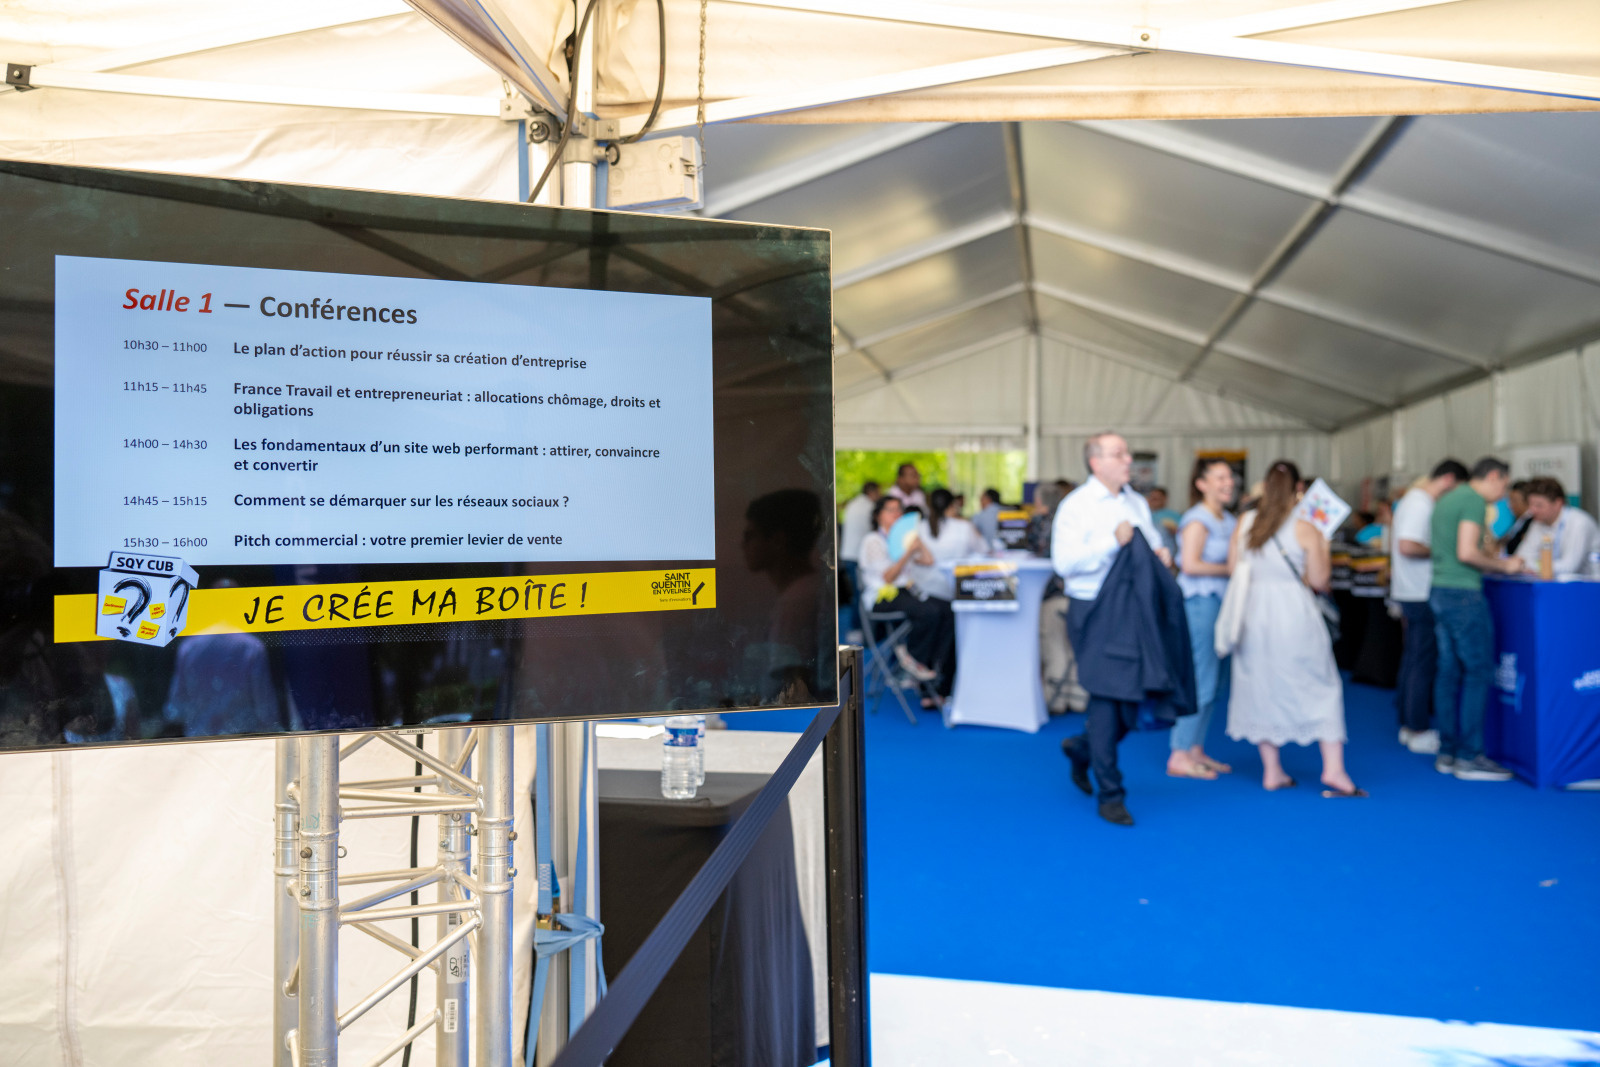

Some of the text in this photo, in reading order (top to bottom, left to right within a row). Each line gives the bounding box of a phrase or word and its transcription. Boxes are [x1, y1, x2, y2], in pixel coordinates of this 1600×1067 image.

[123, 288, 190, 312] Salle
[199, 293, 212, 313] 1
[260, 296, 417, 324] Conférences
[124, 340, 158, 350] 10h30
[173, 342, 207, 352] 11h00
[234, 342, 249, 354] Le
[255, 343, 285, 357] plan
[351, 350, 383, 361] pour
[387, 349, 432, 362] réussir
[436, 354, 449, 363] sa
[454, 352, 507, 365] création
[124, 382, 158, 391] 11h15
[173, 383, 207, 393] 11h45
[234, 383, 282, 396] France
[286, 385, 332, 397] Travail
[337, 387, 350, 398] et
[355, 388, 463, 402] entrepreneuriat
[475, 391, 544, 404] allocations
[548, 393, 607, 408] chômage,
[611, 396, 645, 408] droits
[649, 399, 661, 408] et
[234, 403, 313, 418] obligations
[124, 439, 159, 448] 14h00
[173, 440, 207, 449] 14h30
[234, 438, 257, 450] Les
[261, 438, 366, 452] fondamentaux
[404, 442, 428, 453] site
[432, 442, 460, 454] web
[465, 443, 538, 457] performant
[550, 445, 591, 459] attirer,
[595, 447, 660, 458] convaincre
[234, 459, 318, 471] et convertir
[124, 496, 158, 505] 14h45
[173, 496, 207, 506] 15h15
[234, 494, 569, 509] Comment se démarquer sur les réseaux sociaux ?
[124, 538, 159, 547] 15h30
[174, 537, 207, 547] 16h00
[235, 534, 270, 546] Pitch
[275, 534, 358, 546] commercial
[370, 535, 406, 546] votre
[411, 534, 464, 548] premier
[468, 533, 504, 545] levier
[508, 533, 523, 545] de
[527, 535, 562, 545] vente
[117, 557, 174, 572] SQY CUB
[664, 572, 690, 580] SAINT
[651, 580, 690, 589] QUENTIN
[244, 580, 588, 625] JE CRÉE MA BOÎTE !
